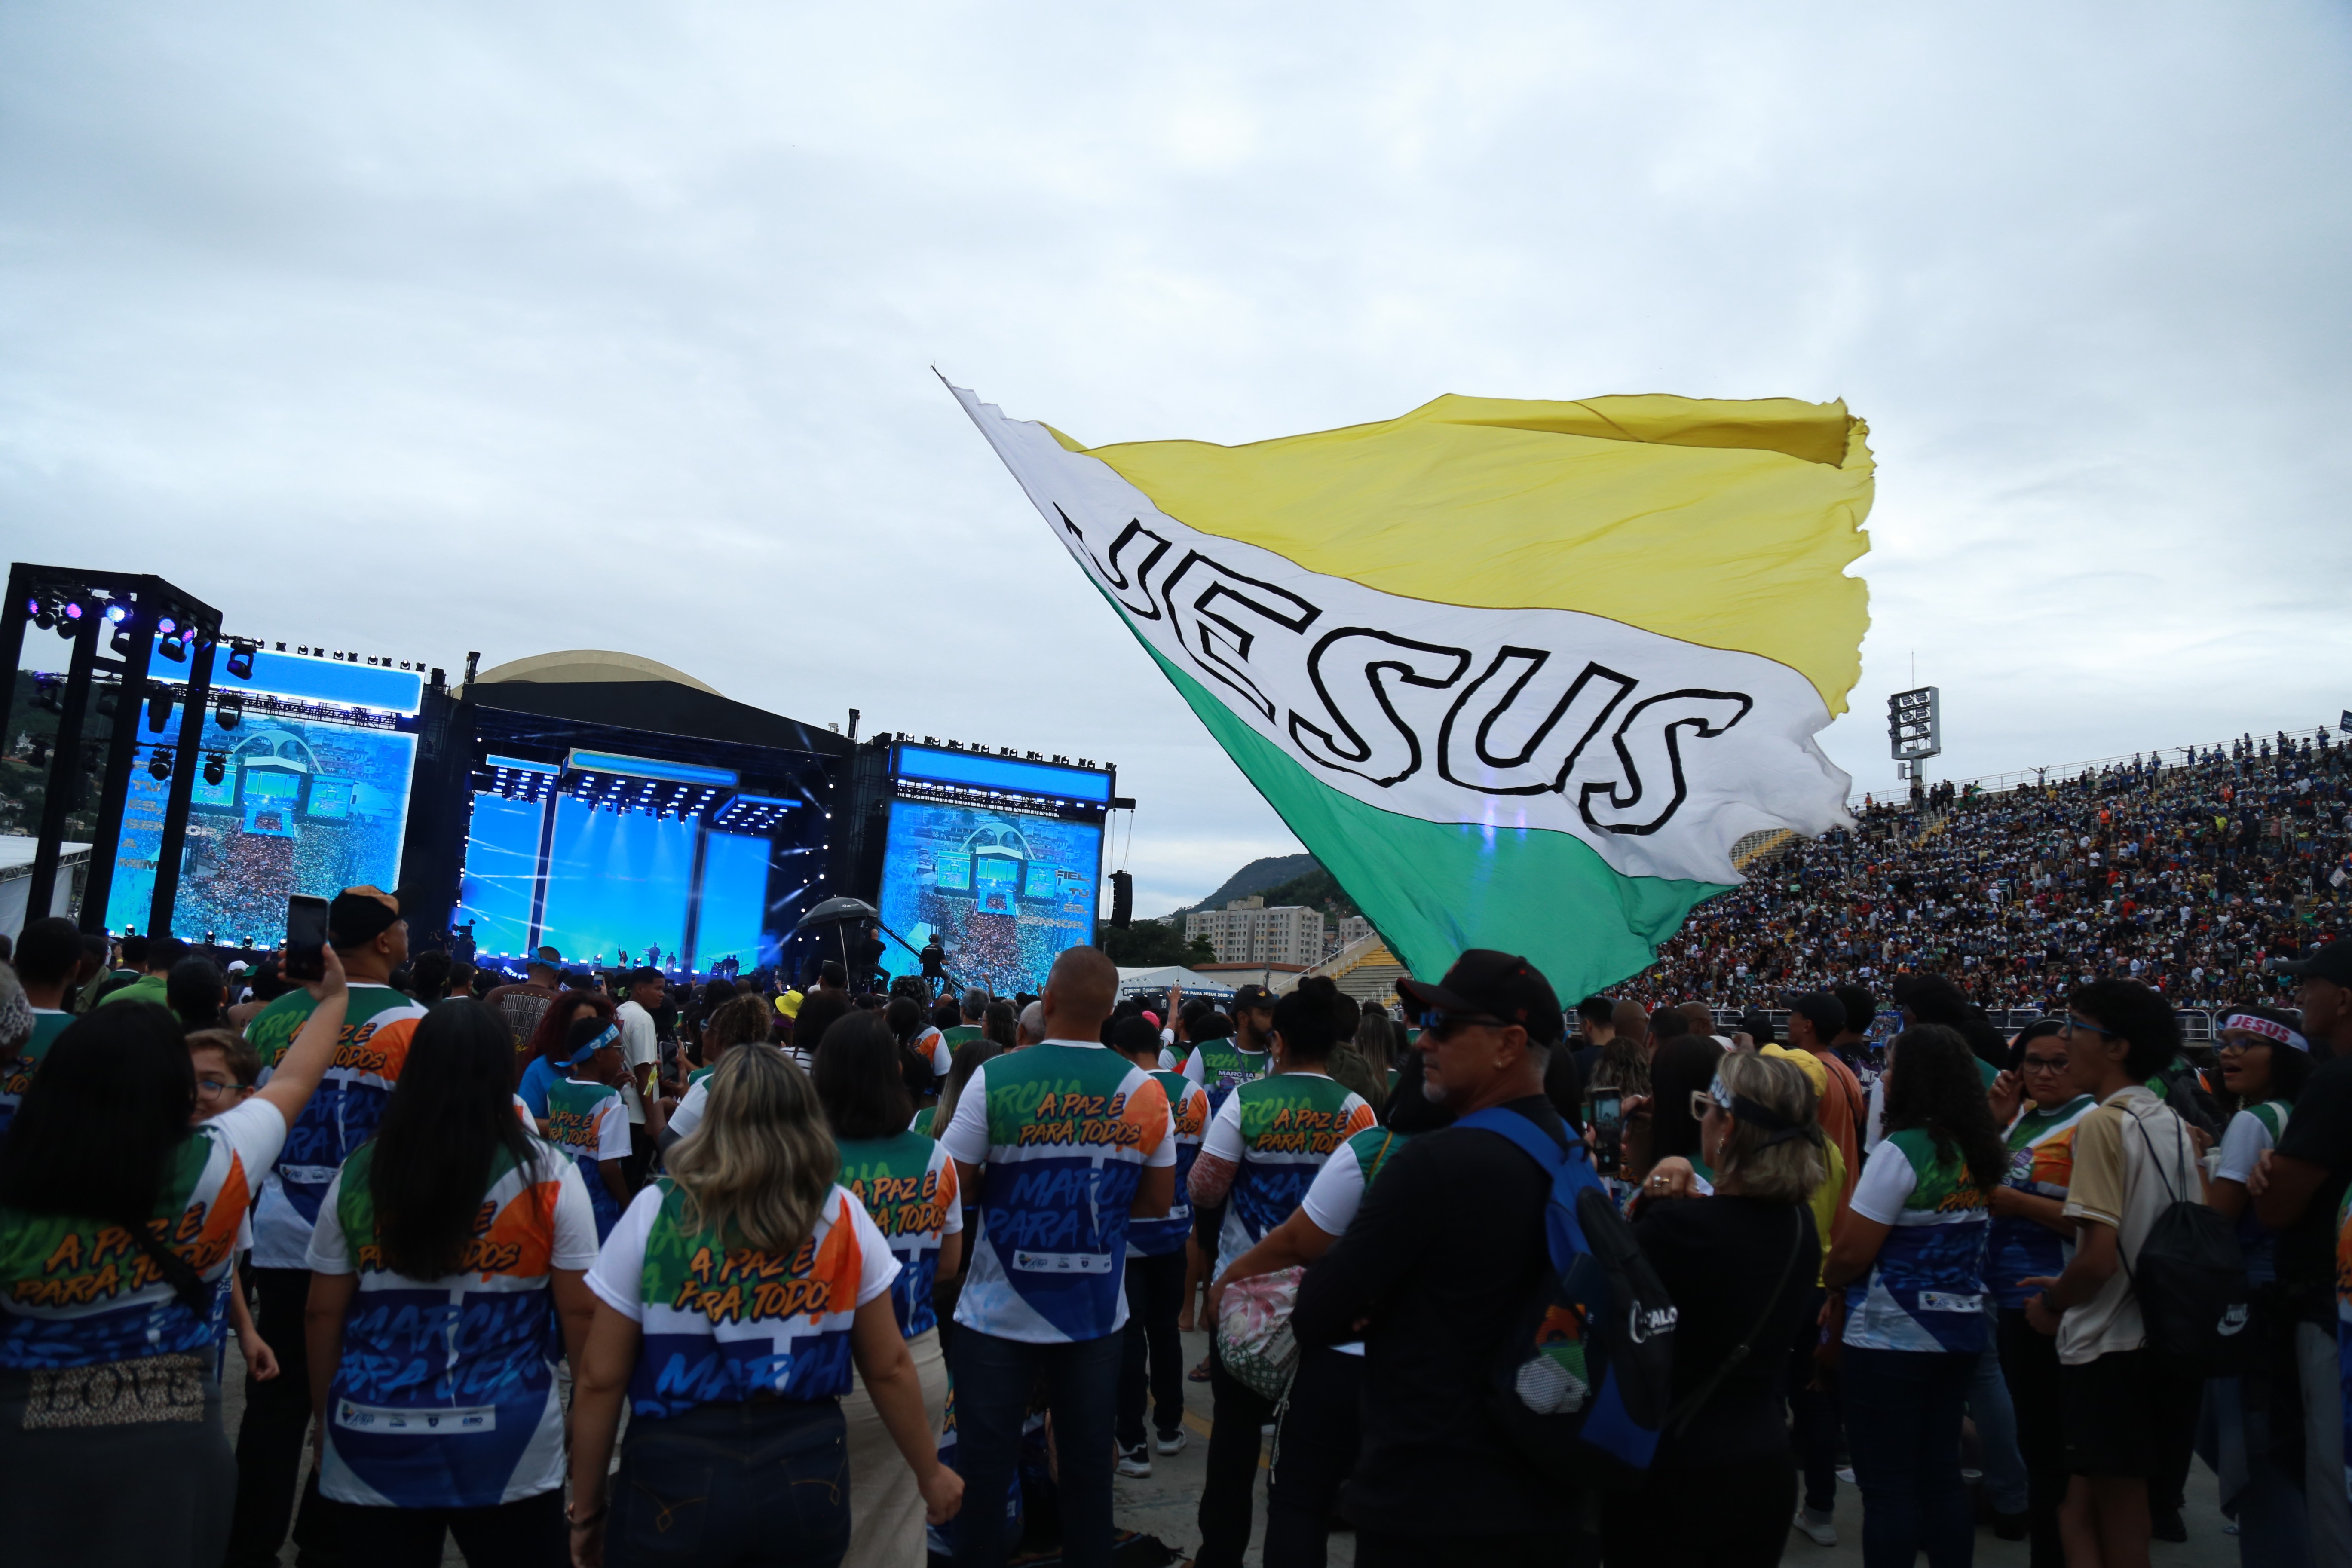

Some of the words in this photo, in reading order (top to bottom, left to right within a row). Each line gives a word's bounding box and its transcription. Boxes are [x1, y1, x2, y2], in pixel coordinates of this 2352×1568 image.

[1053, 501, 1753, 836] JESUS
[131, 779, 162, 792] TU
[1069, 888, 1090, 898] TU
[501, 994, 538, 1012] JUNTOS
[2231, 1015, 2290, 1042] JESUS
[328, 1044, 387, 1070] TODOS
[549, 1109, 557, 1125] A
[557, 1110, 582, 1128] PAZ
[582, 1113, 594, 1129] É
[1036, 1092, 1057, 1120] A
[1060, 1092, 1106, 1118] PAZ
[1106, 1092, 1126, 1117] É
[1272, 1108, 1291, 1130] A
[1293, 1109, 1333, 1130] PAZ
[1333, 1110, 1348, 1130] É
[1017, 1118, 1078, 1148] PARA
[1079, 1118, 1142, 1145] TODOS
[1255, 1131, 1307, 1155] PARA
[1309, 1131, 1347, 1156] TOD
[872, 1176, 918, 1208] PAZ
[921, 1170, 937, 1200] É
[896, 1202, 946, 1238] TODOS
[983, 1207, 1081, 1248] PARA
[45, 1232, 83, 1276] A
[172, 1202, 206, 1242] É
[717, 1247, 787, 1283] PAZ
[11, 1263, 121, 1309] PARA
[45, 1365, 197, 1412] LOVE
